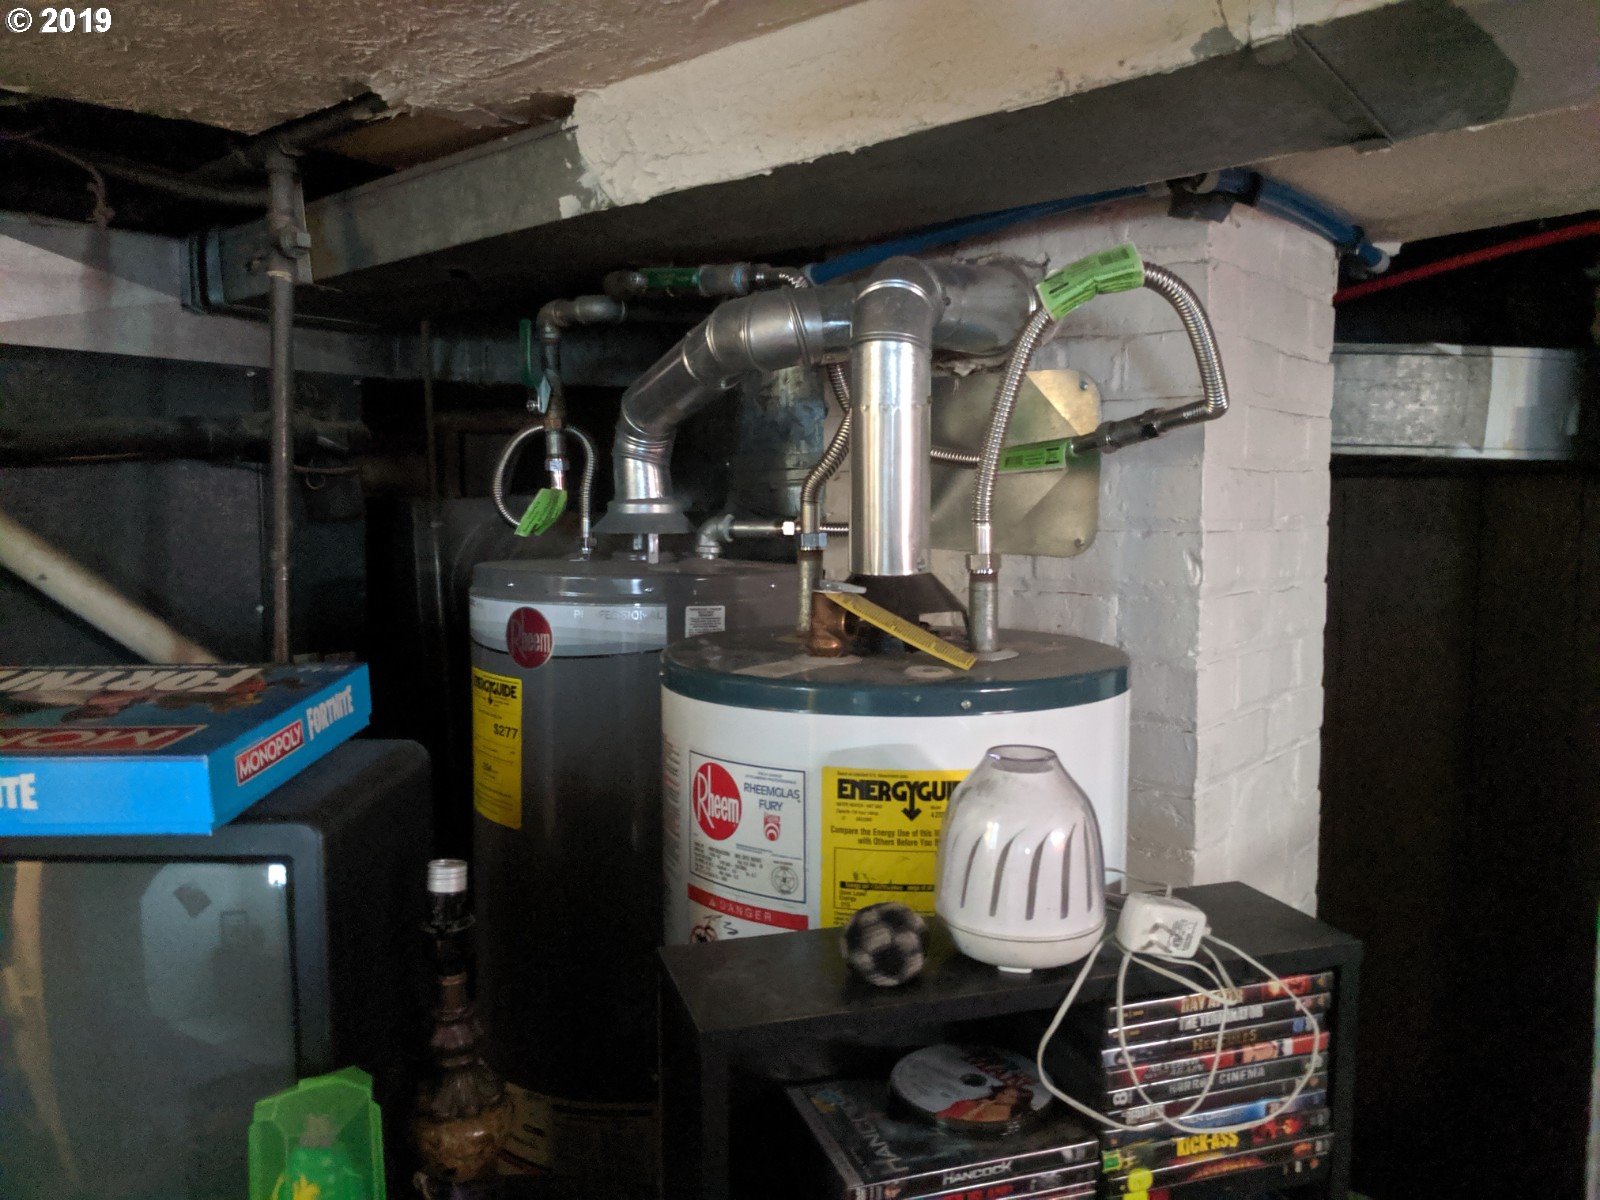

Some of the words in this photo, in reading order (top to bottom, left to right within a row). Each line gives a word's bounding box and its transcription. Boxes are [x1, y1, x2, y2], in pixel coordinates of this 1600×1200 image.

[510, 609, 551, 661] Rheem
[239, 724, 302, 780] MONOPOLY
[306, 685, 354, 741] FORTNITE
[493, 723, 519, 739] $277
[696, 764, 741, 829] Rheem
[837, 778, 961, 804] ENERGYGUI
[758, 799, 784, 812] FURY
[719, 900, 772, 922] DANGER
[1219, 1066, 1265, 1085] CINEMA
[1172, 1131, 1240, 1157] KICK-ASS
[942, 1160, 1013, 1185] HANCOCK
